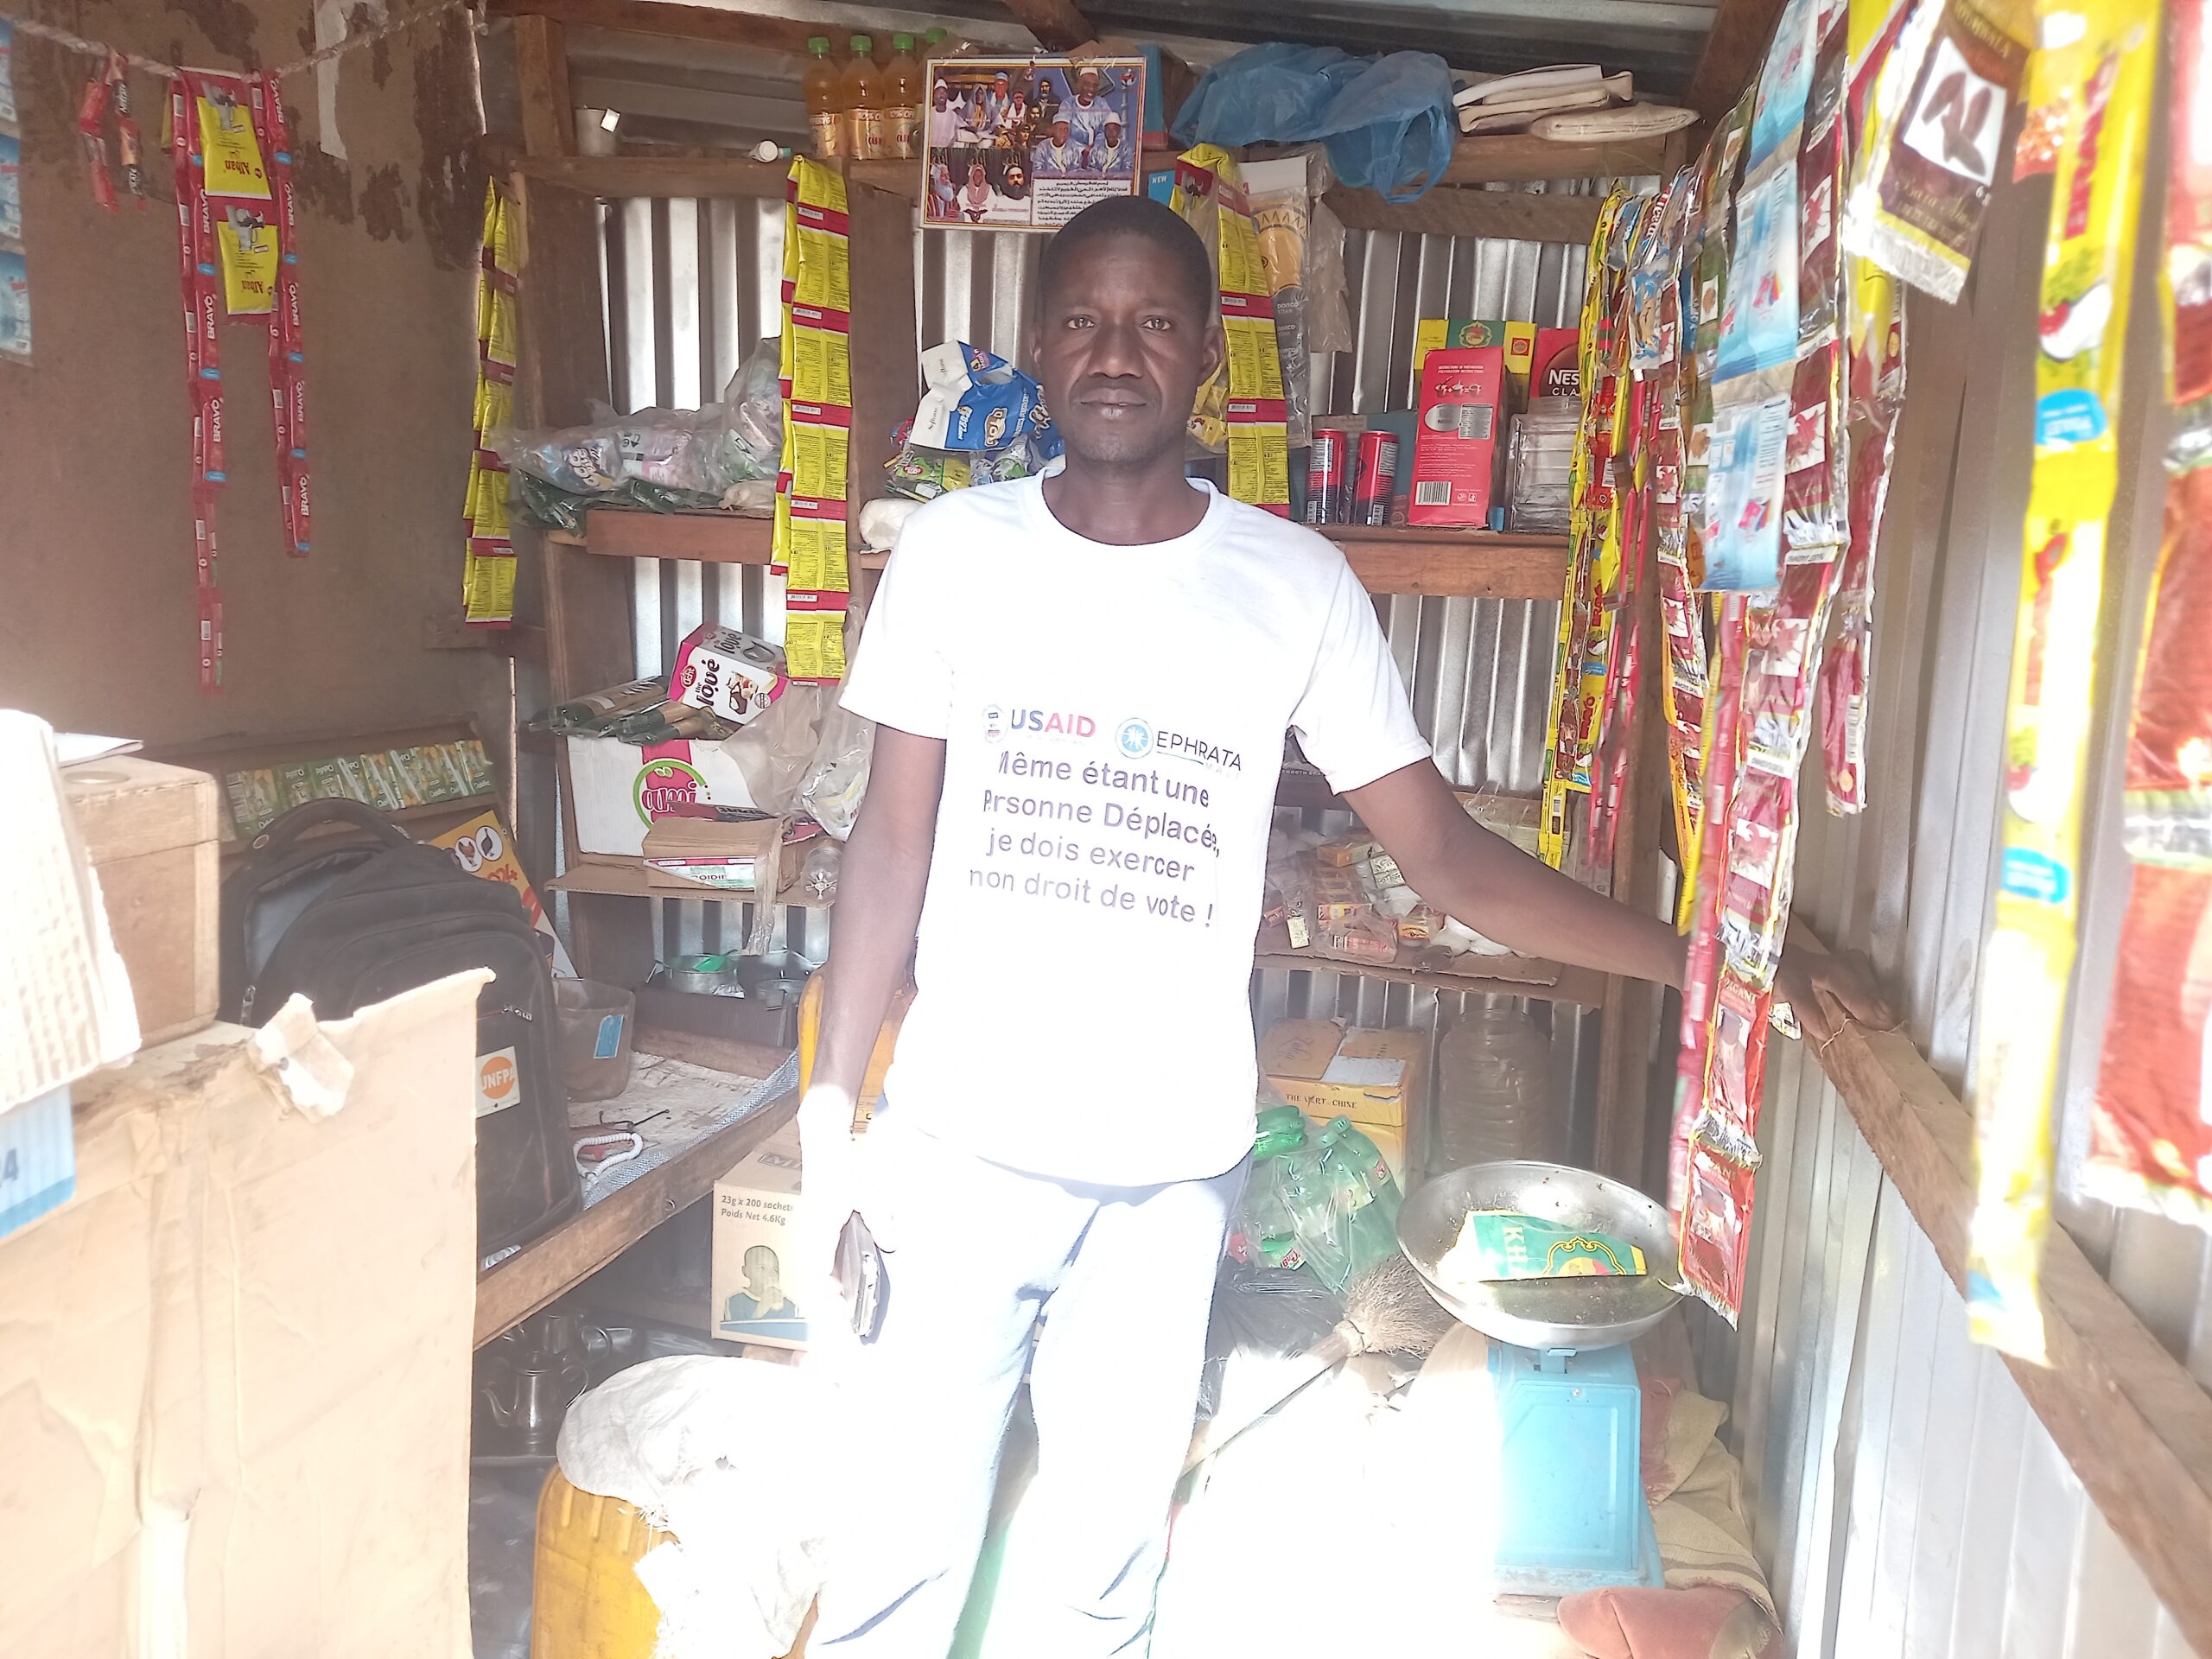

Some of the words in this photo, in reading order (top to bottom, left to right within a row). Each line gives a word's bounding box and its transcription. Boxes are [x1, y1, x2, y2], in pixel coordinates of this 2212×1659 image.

[270, 77, 284, 124] BRAVO
[1151, 175, 1167, 184] NEW
[284, 181, 295, 226] BRAVO
[203, 294, 217, 340] BRAVO
[288, 282, 300, 327] BRAVO
[1548, 369, 1580, 385] NES
[1552, 387, 1580, 397] CLA
[210, 397, 224, 442] BRAVO
[295, 380, 305, 423] BRAVO
[298, 474, 310, 517] BRAVO
[1010, 708, 1097, 739] USAID
[1156, 731, 1243, 772] EPHRATA
[1082, 761, 1159, 795] étant
[1166, 779, 1210, 808] une
[986, 827, 1013, 856] je
[1020, 832, 1080, 861] dois
[1090, 847, 1195, 881] exercer
[1024, 873, 1091, 904] droit
[1100, 885, 1136, 910] de
[1147, 893, 1197, 923] vote
[1204, 903, 1214, 928] !
[1332, 1100, 1357, 1109] CHINE
[721, 1195, 736, 1206] 23g
[746, 1198, 761, 1207] 200
[721, 1208, 743, 1218] Poids
[746, 1211, 760, 1221] Net
[762, 1213, 785, 1226] 4.6Kg
